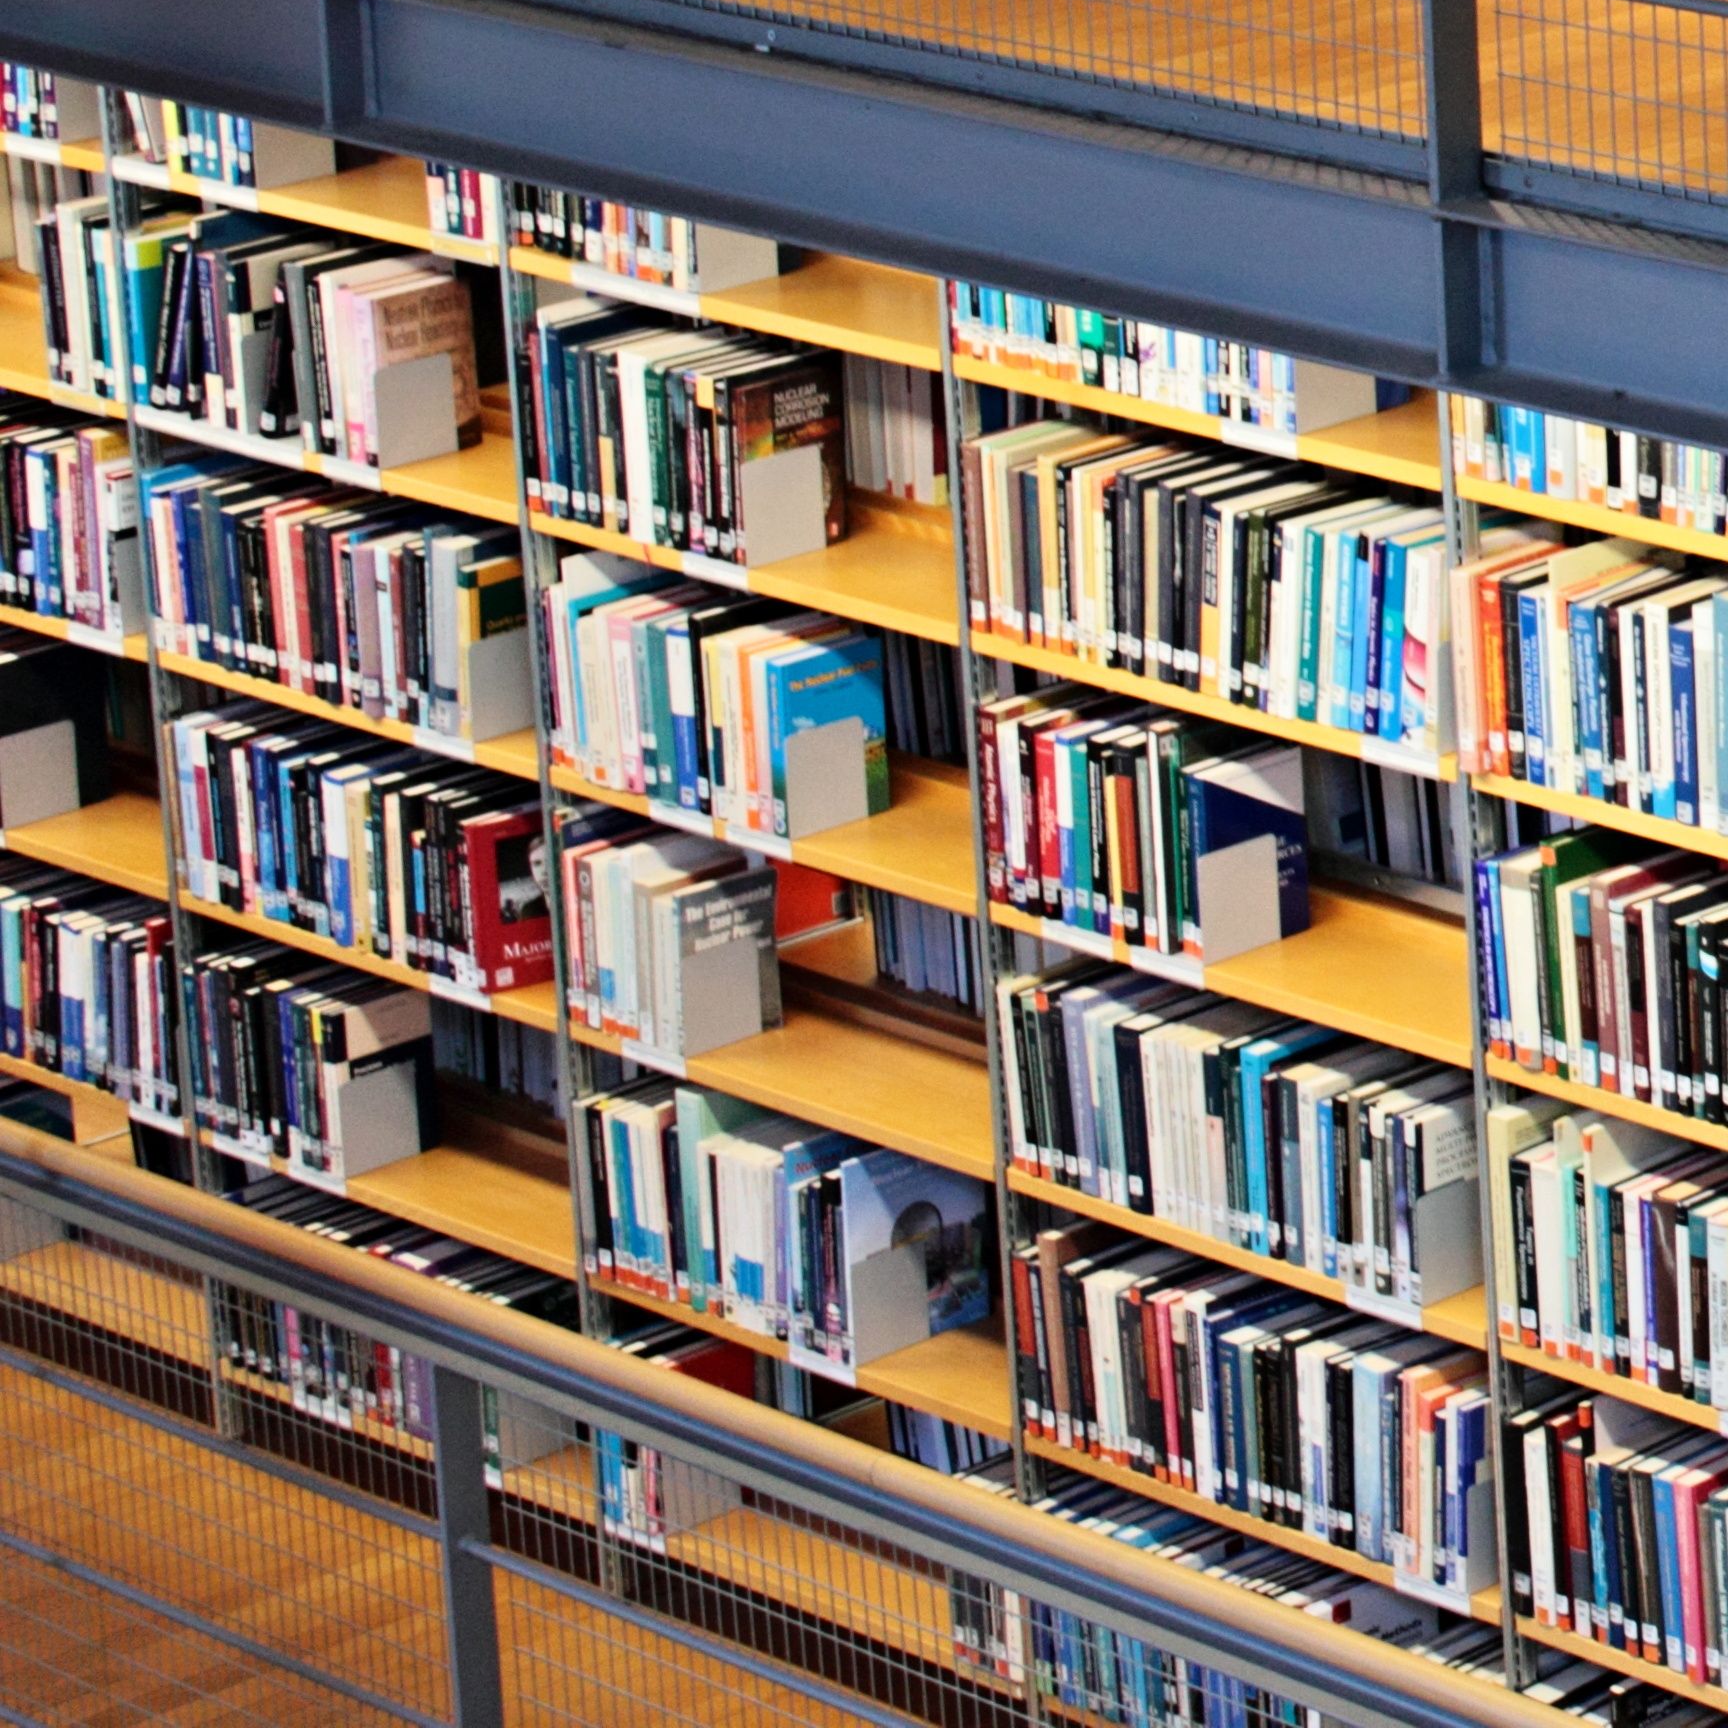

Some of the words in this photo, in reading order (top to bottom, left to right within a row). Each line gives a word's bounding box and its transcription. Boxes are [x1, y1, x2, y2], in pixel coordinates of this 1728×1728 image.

[773, 383, 818, 403] NUCLEAR
[773, 393, 831, 417] CORROSION
[774, 405, 824, 429] MODELING
[685, 905, 704, 924] The
[503, 939, 553, 961] MAJOR
